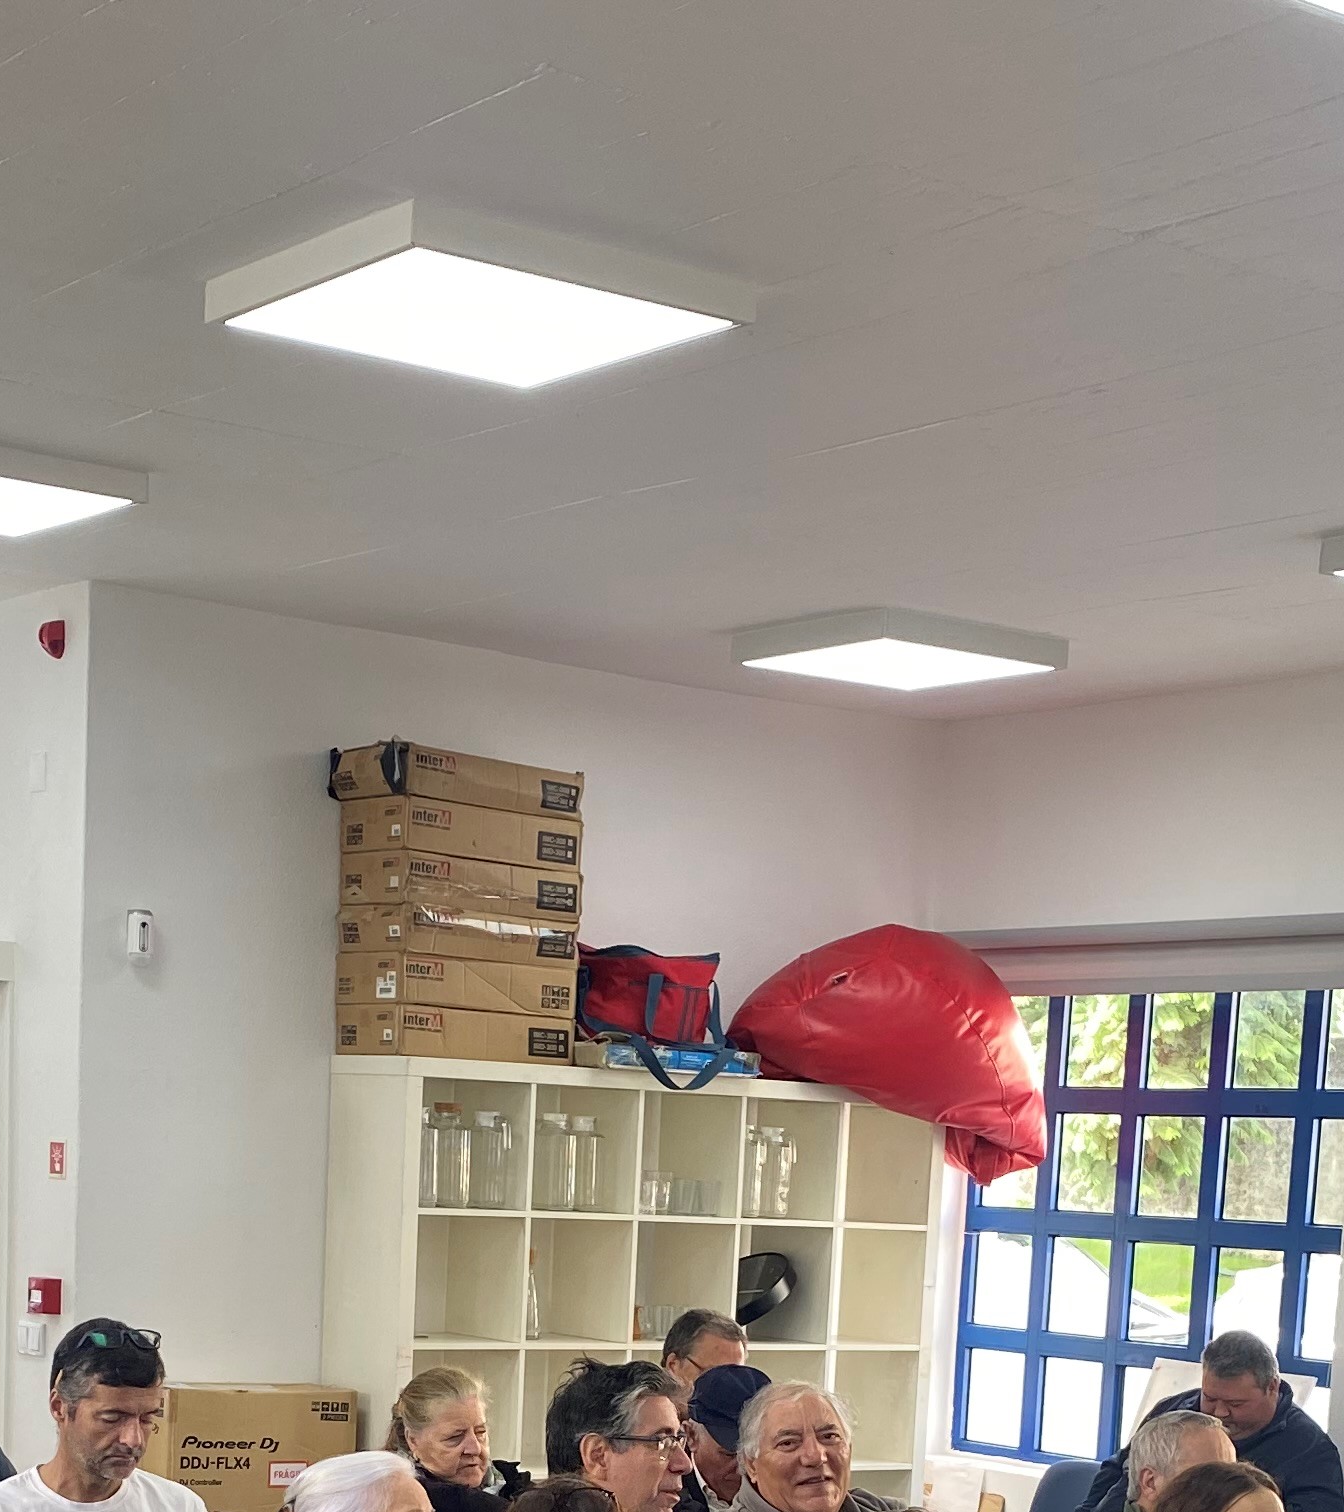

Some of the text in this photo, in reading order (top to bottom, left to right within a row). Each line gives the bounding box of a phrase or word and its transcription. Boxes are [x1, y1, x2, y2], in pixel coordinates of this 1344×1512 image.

[181, 1436, 256, 1449] Pioneer
[179, 1456, 250, 1469] DDJ-FLX4
[189, 1478, 222, 1486] Controller
